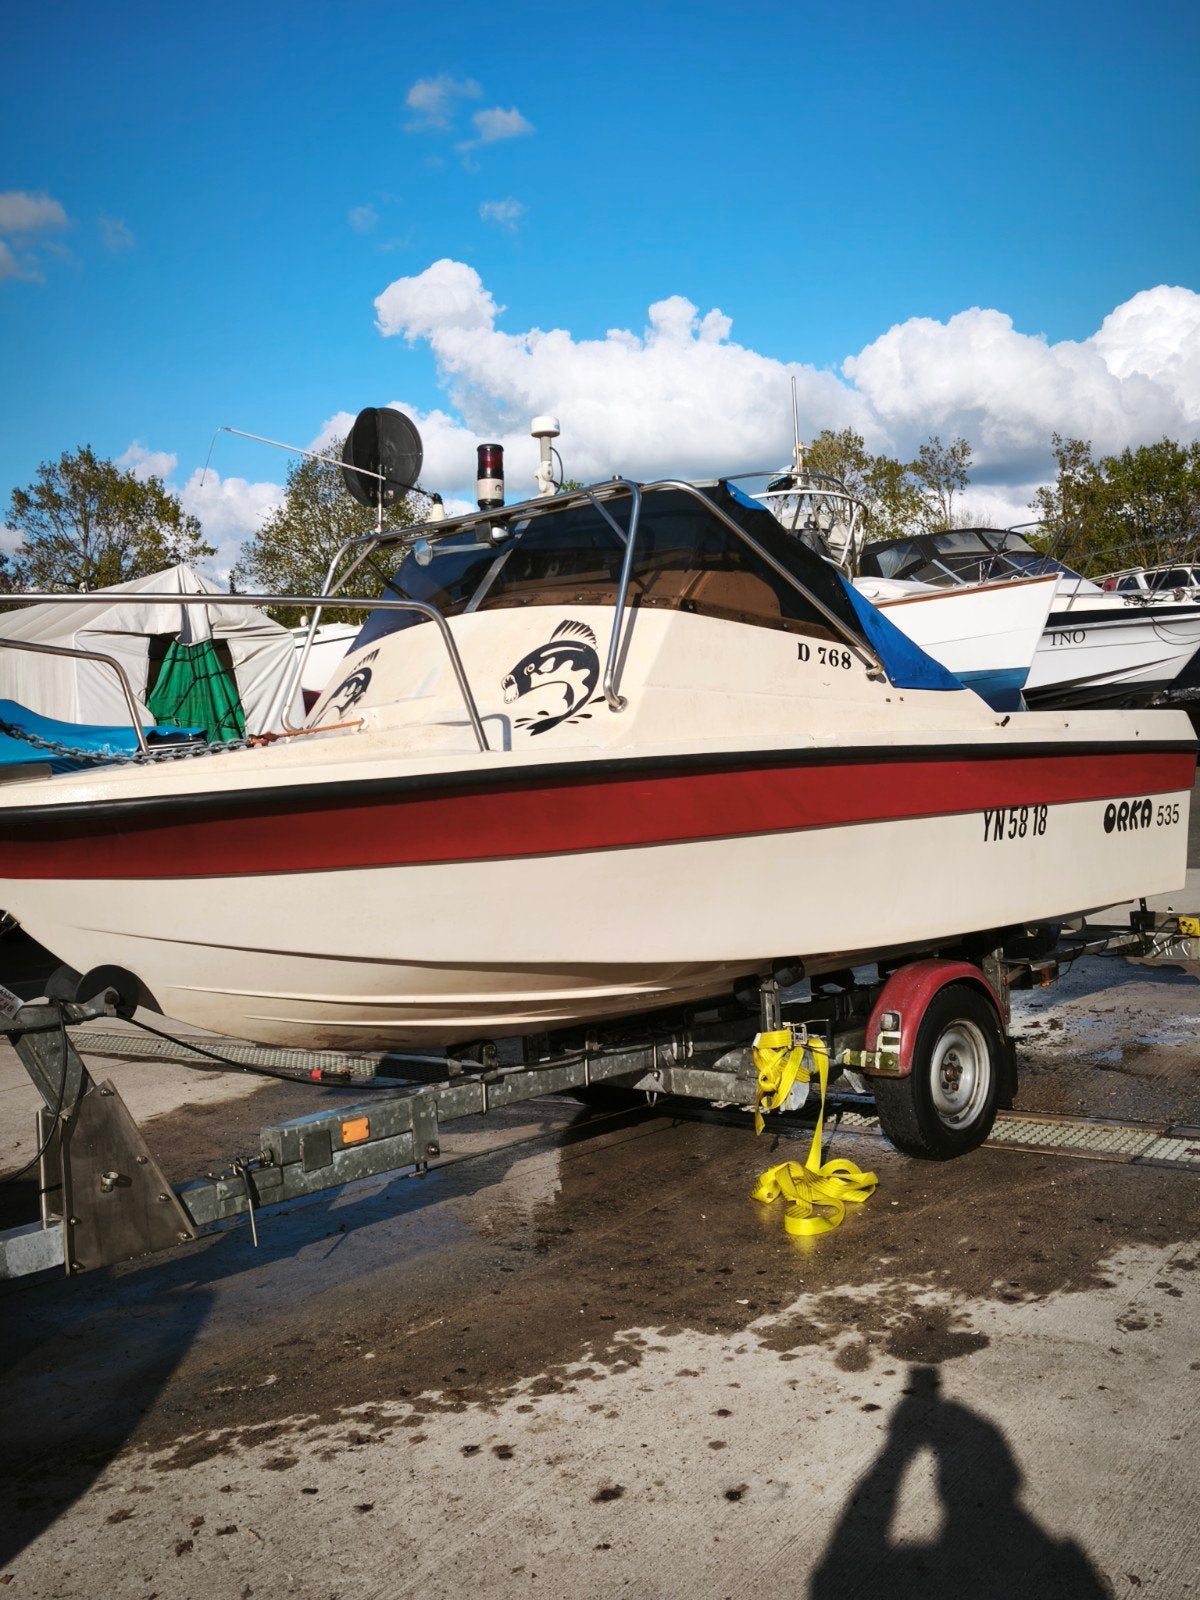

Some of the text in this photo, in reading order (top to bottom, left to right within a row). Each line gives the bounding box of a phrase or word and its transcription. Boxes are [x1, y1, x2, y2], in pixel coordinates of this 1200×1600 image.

[797, 642, 852, 670] D 768
[1103, 798, 1180, 834] ORKA 535
